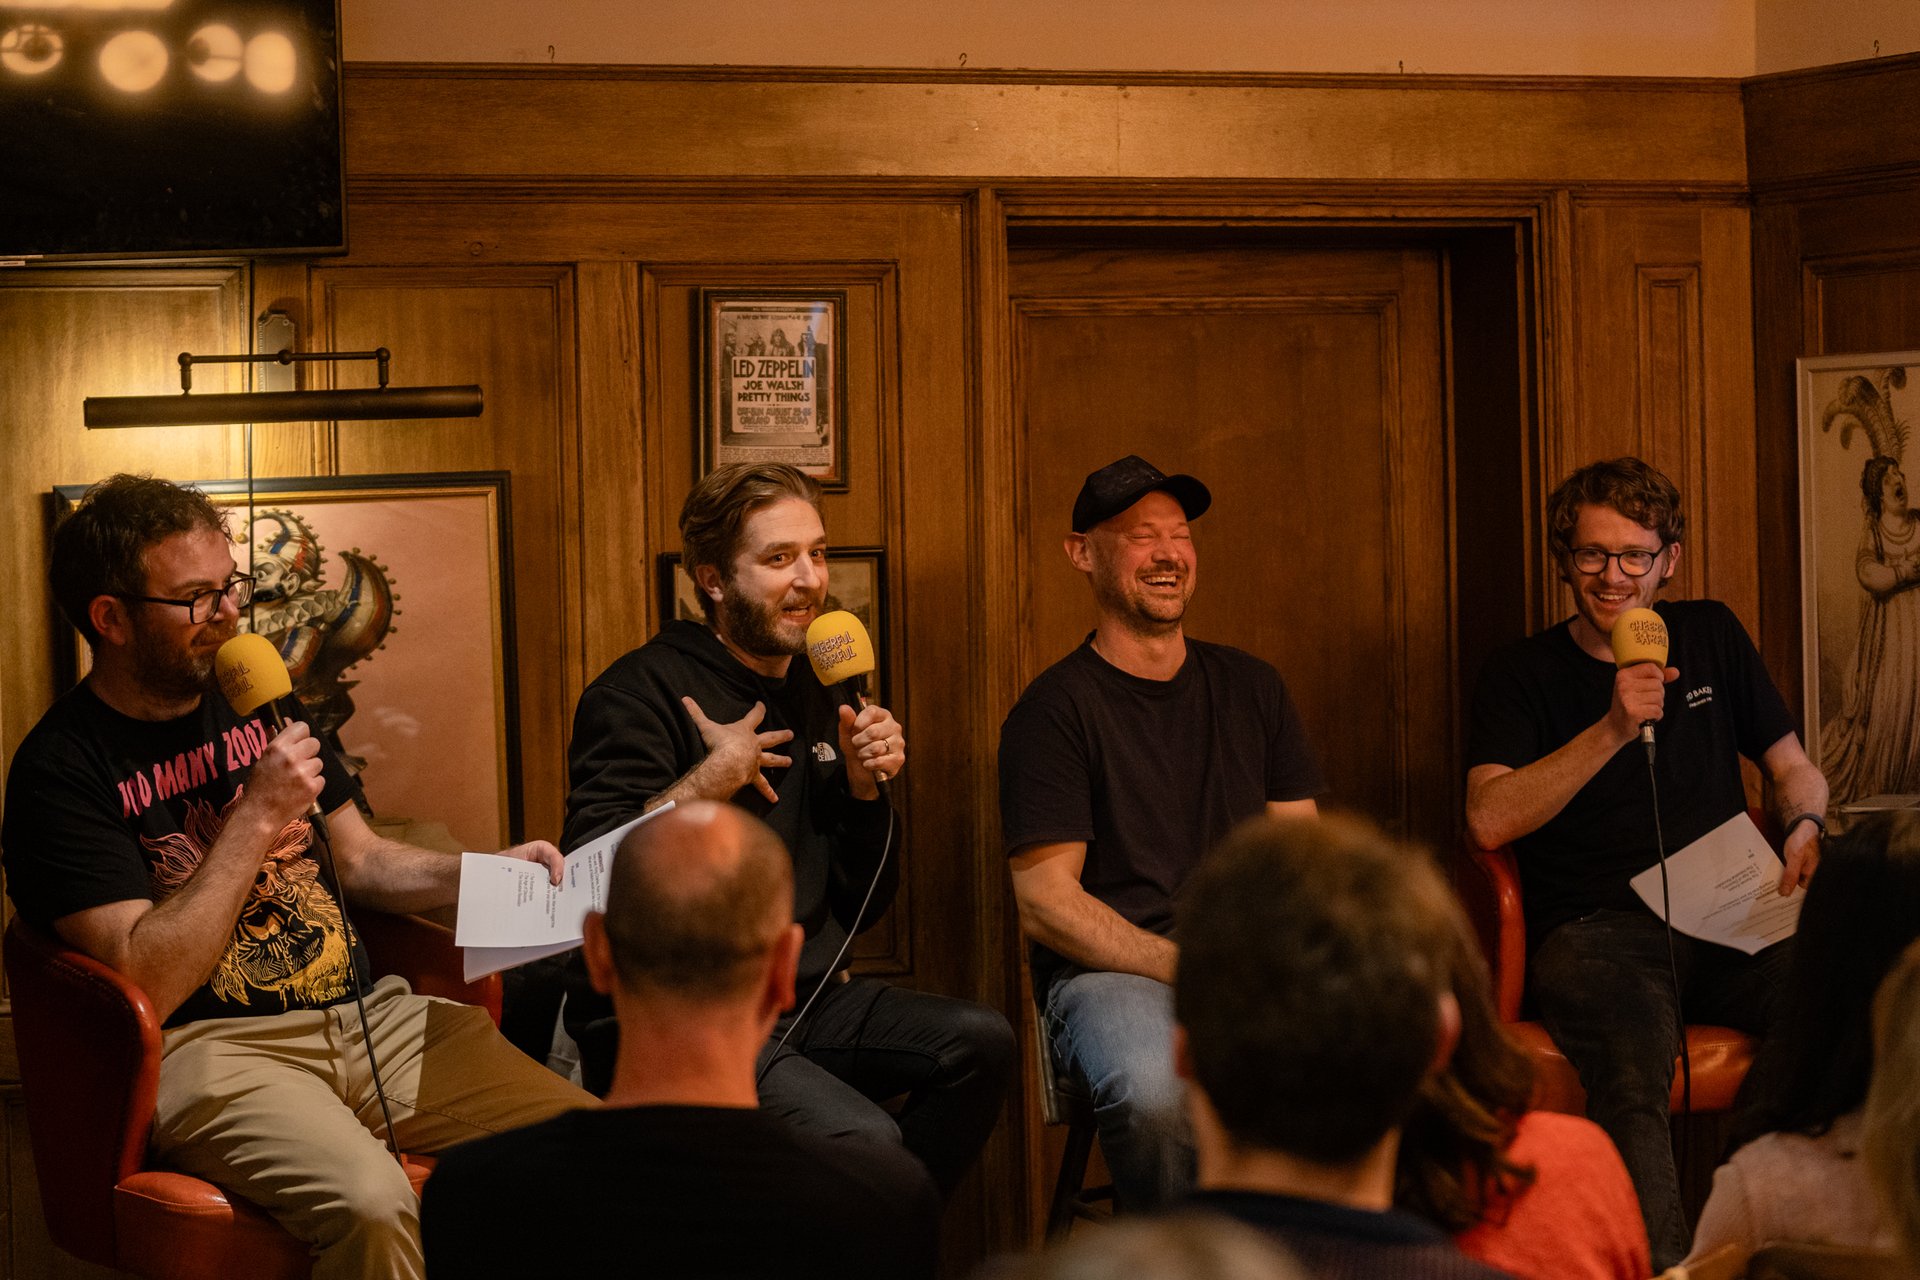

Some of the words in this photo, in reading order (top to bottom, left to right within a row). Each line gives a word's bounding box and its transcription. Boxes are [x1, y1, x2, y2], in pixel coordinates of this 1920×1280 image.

[733, 359, 755, 378] LED
[758, 359, 815, 378] ZEPPELIN
[743, 380, 763, 390] JOE
[766, 380, 804, 390] WALSH
[737, 392, 771, 402] PRETTY
[774, 392, 810, 402] THINGS
[153, 741, 219, 801] MANY
